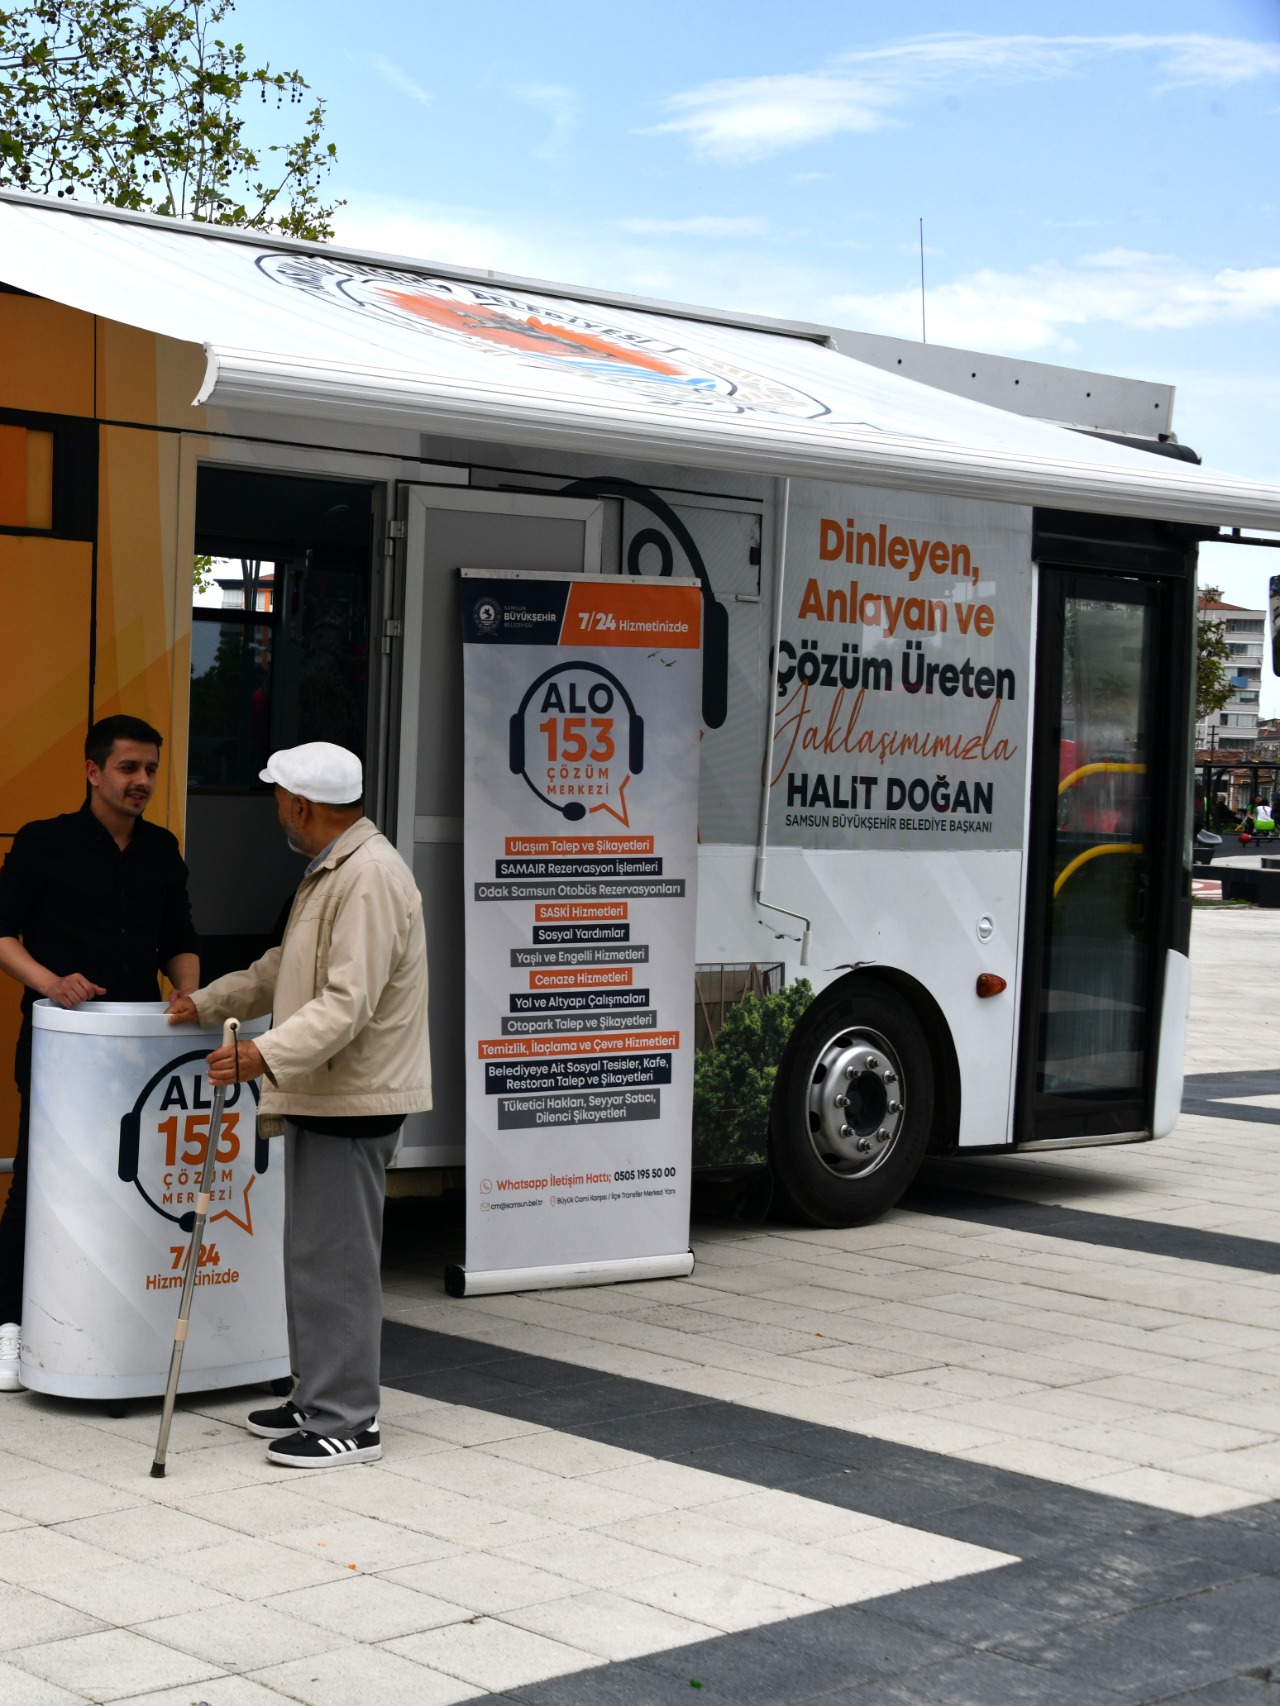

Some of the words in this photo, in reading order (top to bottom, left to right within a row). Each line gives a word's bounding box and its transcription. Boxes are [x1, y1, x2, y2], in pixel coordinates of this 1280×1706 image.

[819, 518, 980, 586] Dinleyen,
[504, 611, 556, 622] BÜYÜKŞEHİR
[797, 578, 948, 638] Anlayan
[954, 602, 994, 637] ve
[578, 610, 616, 632] 7/24
[619, 619, 688, 632] Hizmetinizde
[769, 639, 893, 697] Çözüm
[901, 640, 1015, 700] Üreten
[540, 682, 614, 714] ALO
[539, 717, 615, 762] 153
[761, 679, 1018, 788] Yaklaşımımızla
[546, 764, 609, 782] ÇÖZÜM
[547, 782, 609, 795] MERKEZİ
[786, 772, 878, 809] HALİT
[886, 774, 993, 814] DOĞAN
[785, 814, 830, 828] SAMSUN
[832, 814, 896, 831] BÜYÜKŞEHİR
[899, 816, 947, 832] BELEDİYE
[949, 819, 992, 834] BAŞKANI
[510, 841, 548, 854] Ulaşım
[550, 840, 580, 853] Talep
[596, 839, 650, 853] Şikayetleri
[500, 863, 546, 875] SAMAIR
[548, 862, 614, 876] Rezervasyon
[616, 859, 658, 874] İşlemleri
[478, 887, 509, 897] Odak
[511, 886, 556, 897] Samsun
[558, 884, 596, 896] Otobüs
[599, 882, 680, 896] Rezervasyonları
[540, 904, 570, 918] SASKİ
[572, 904, 624, 917] Hizmetleri
[538, 929, 573, 942] Sosyal
[575, 927, 625, 939] Yardımlar
[516, 952, 542, 966] Yaşlı
[543, 954, 556, 962] ve
[558, 950, 593, 964] Engelli
[595, 947, 645, 961] Hizmetleri
[535, 974, 575, 985] Cenaze
[577, 971, 628, 983] Hizmetleri
[516, 997, 532, 1009] Yol
[534, 1000, 547, 1008] ve
[548, 996, 586, 1009] Altyapı
[588, 993, 646, 1007] Çalışmaları
[507, 1019, 553, 1033] Otopark
[555, 1018, 583, 1030] Talep
[585, 1020, 598, 1028] ve
[600, 1014, 652, 1028] Şikayetleri
[482, 1042, 529, 1055] Temizlik,
[531, 1039, 577, 1053] İlaçlama
[579, 1041, 591, 1050] ve
[593, 1039, 623, 1052] Çevre
[625, 1034, 676, 1048] Hizmetleri
[488, 1063, 548, 1078] Belediyeye
[550, 1062, 565, 1074] Ait
[566, 1060, 601, 1074] Sosyal
[602, 1058, 641, 1071] Tesisler,
[643, 1056, 669, 1069] Kafe,
[506, 1078, 554, 1089] Restoran
[556, 1075, 585, 1088] Talep
[587, 1077, 599, 1085] ve
[601, 1071, 653, 1086] Şikayetleri
[503, 1099, 545, 1112] Tüketici
[547, 1097, 586, 1110] Hakları,
[588, 1095, 623, 1107] Seyyar
[625, 1093, 656, 1104] Satıcı,
[536, 1110, 571, 1123] Dilenci
[573, 1106, 626, 1122] Şikayetleri
[158, 1112, 240, 1166] 153
[497, 1178, 548, 1191] Whatsapp
[550, 1173, 584, 1188] İletişim
[586, 1173, 612, 1184] Hattı;
[614, 1170, 635, 1181] 0505
[636, 1169, 650, 1180] 195
[651, 1168, 662, 1178] 50
[664, 1166, 676, 1177] 00
[162, 1186, 232, 1205] MEREZİ
[557, 1197, 573, 1205] Büyük
[574, 1195, 589, 1203] Cami
[621, 1191, 642, 1199] Transfer
[170, 1243, 220, 1270] 7/24
[146, 1268, 239, 1290] Hizmtinizde
